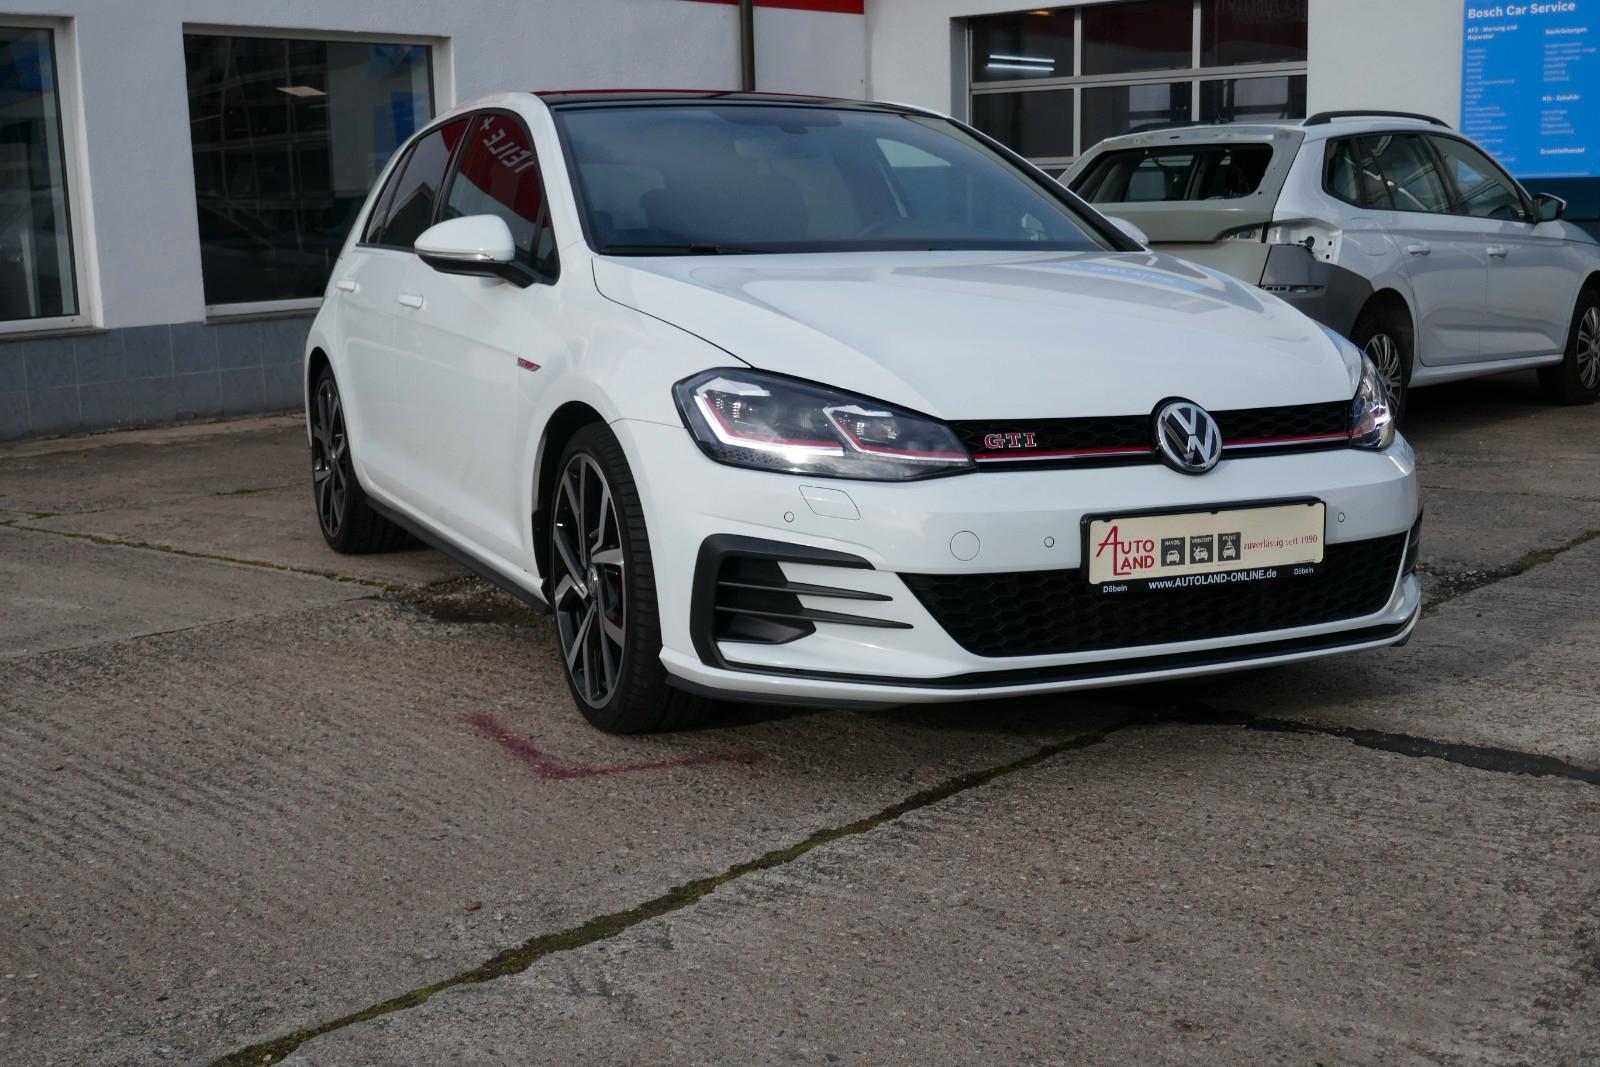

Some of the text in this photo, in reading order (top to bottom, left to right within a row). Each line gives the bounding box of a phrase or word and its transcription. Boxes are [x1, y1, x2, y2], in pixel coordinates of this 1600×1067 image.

[1468, 1, 1576, 19] Bosch Car Service
[984, 432, 1037, 449] GTI
[1158, 403, 1222, 472] VW
[1096, 526, 1155, 558] AUTO
[1300, 534, 1318, 545] 1990
[1113, 555, 1155, 577] LAND
[1294, 566, 1314, 576] Döbeln
[1103, 585, 1128, 593] Döbeln
